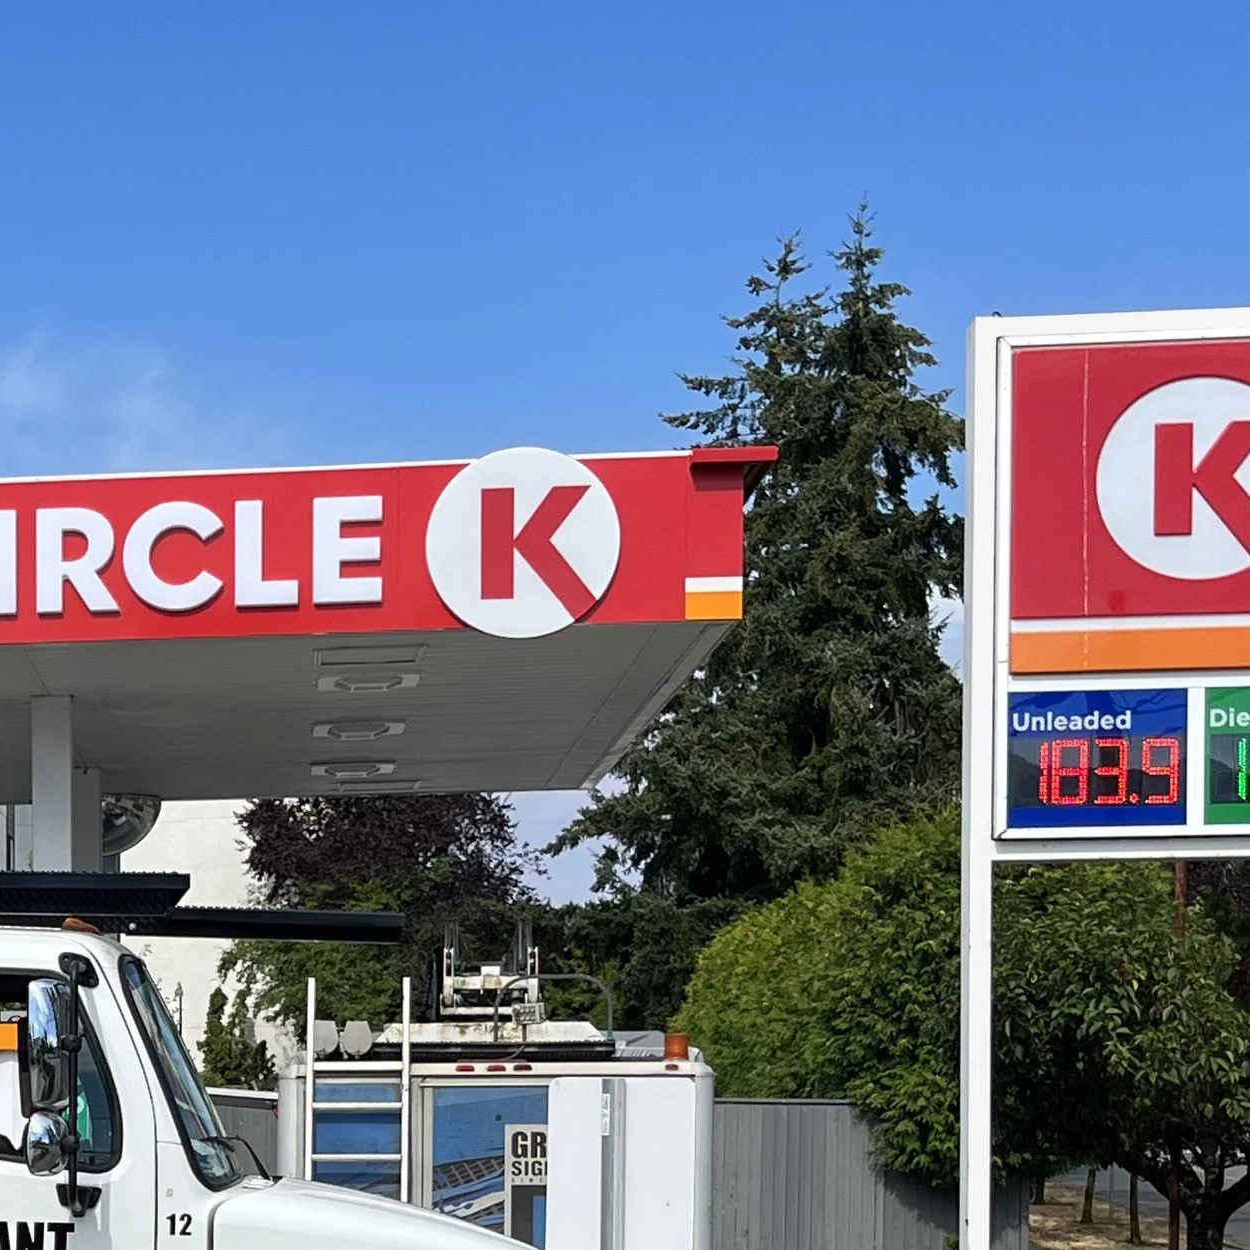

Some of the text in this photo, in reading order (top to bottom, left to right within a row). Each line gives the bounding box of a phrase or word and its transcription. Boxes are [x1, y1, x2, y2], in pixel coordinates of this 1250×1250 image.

[1153, 420, 1250, 557] K
[480, 484, 598, 623] K
[1012, 710, 1131, 731] Unleaded
[1210, 707, 1250, 727] Die
[1039, 738, 1180, 804] 183.9
[511, 1160, 547, 1176] SIG
[166, 1213, 192, 1236] 12
